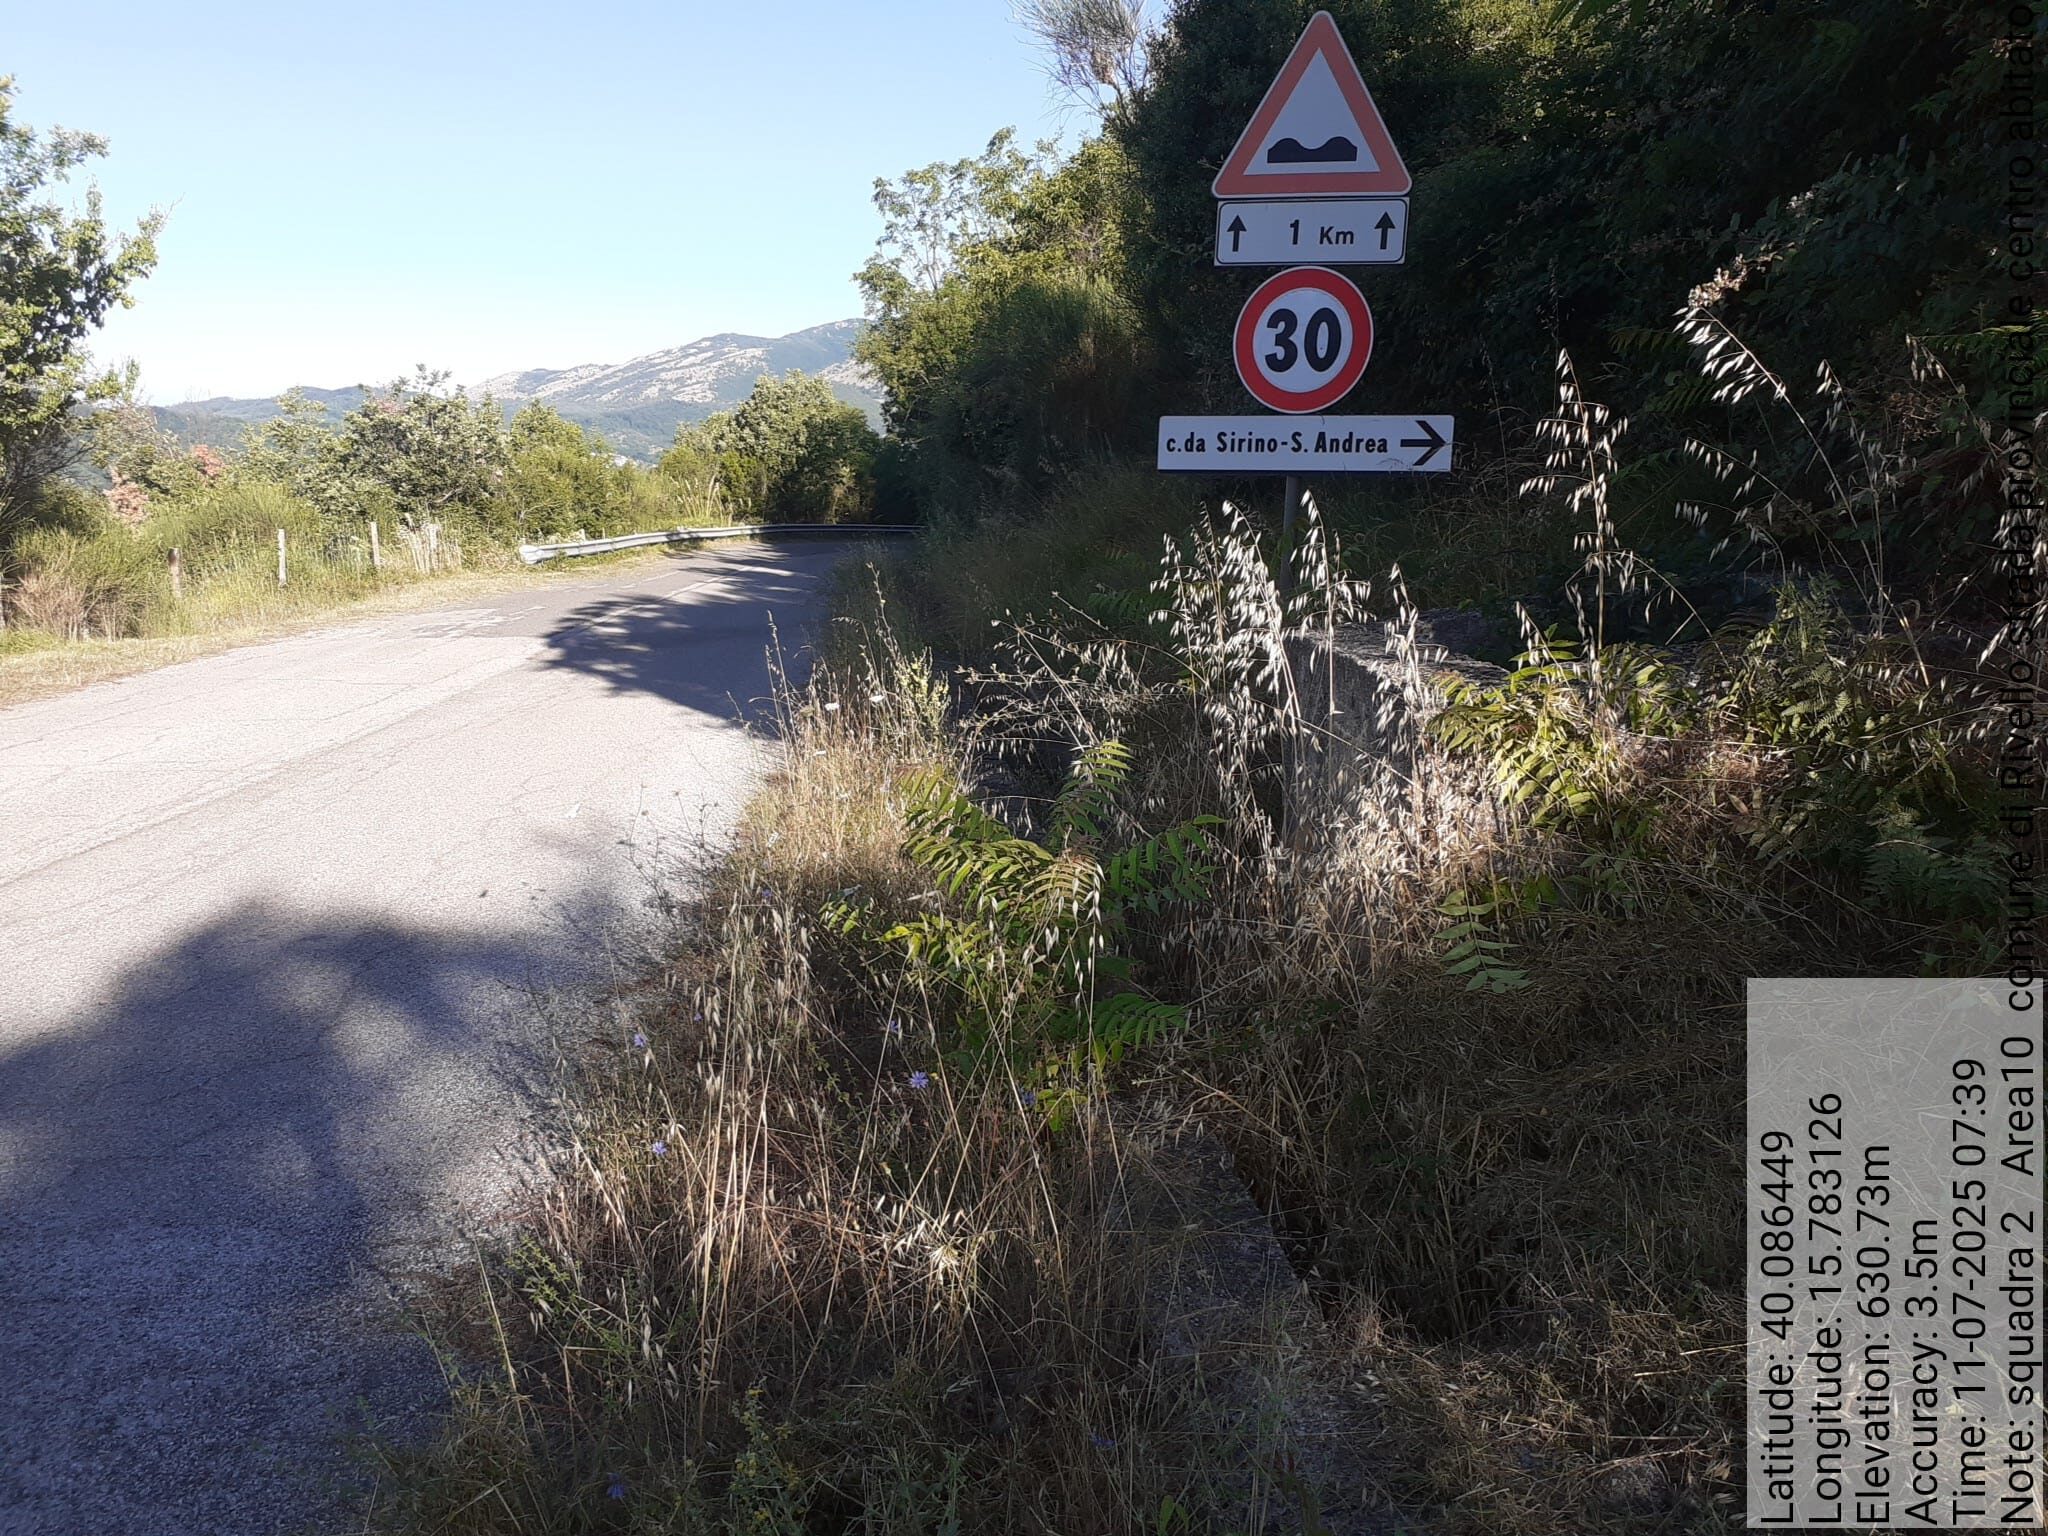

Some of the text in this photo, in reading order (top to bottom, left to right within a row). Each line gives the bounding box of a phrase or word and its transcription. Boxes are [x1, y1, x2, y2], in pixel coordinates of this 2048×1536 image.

[1290, 219, 1354, 245] 1 Km
[1264, 307, 1342, 373] 30
[1166, 431, 1388, 453] c.da Sirino-S. Andrea
